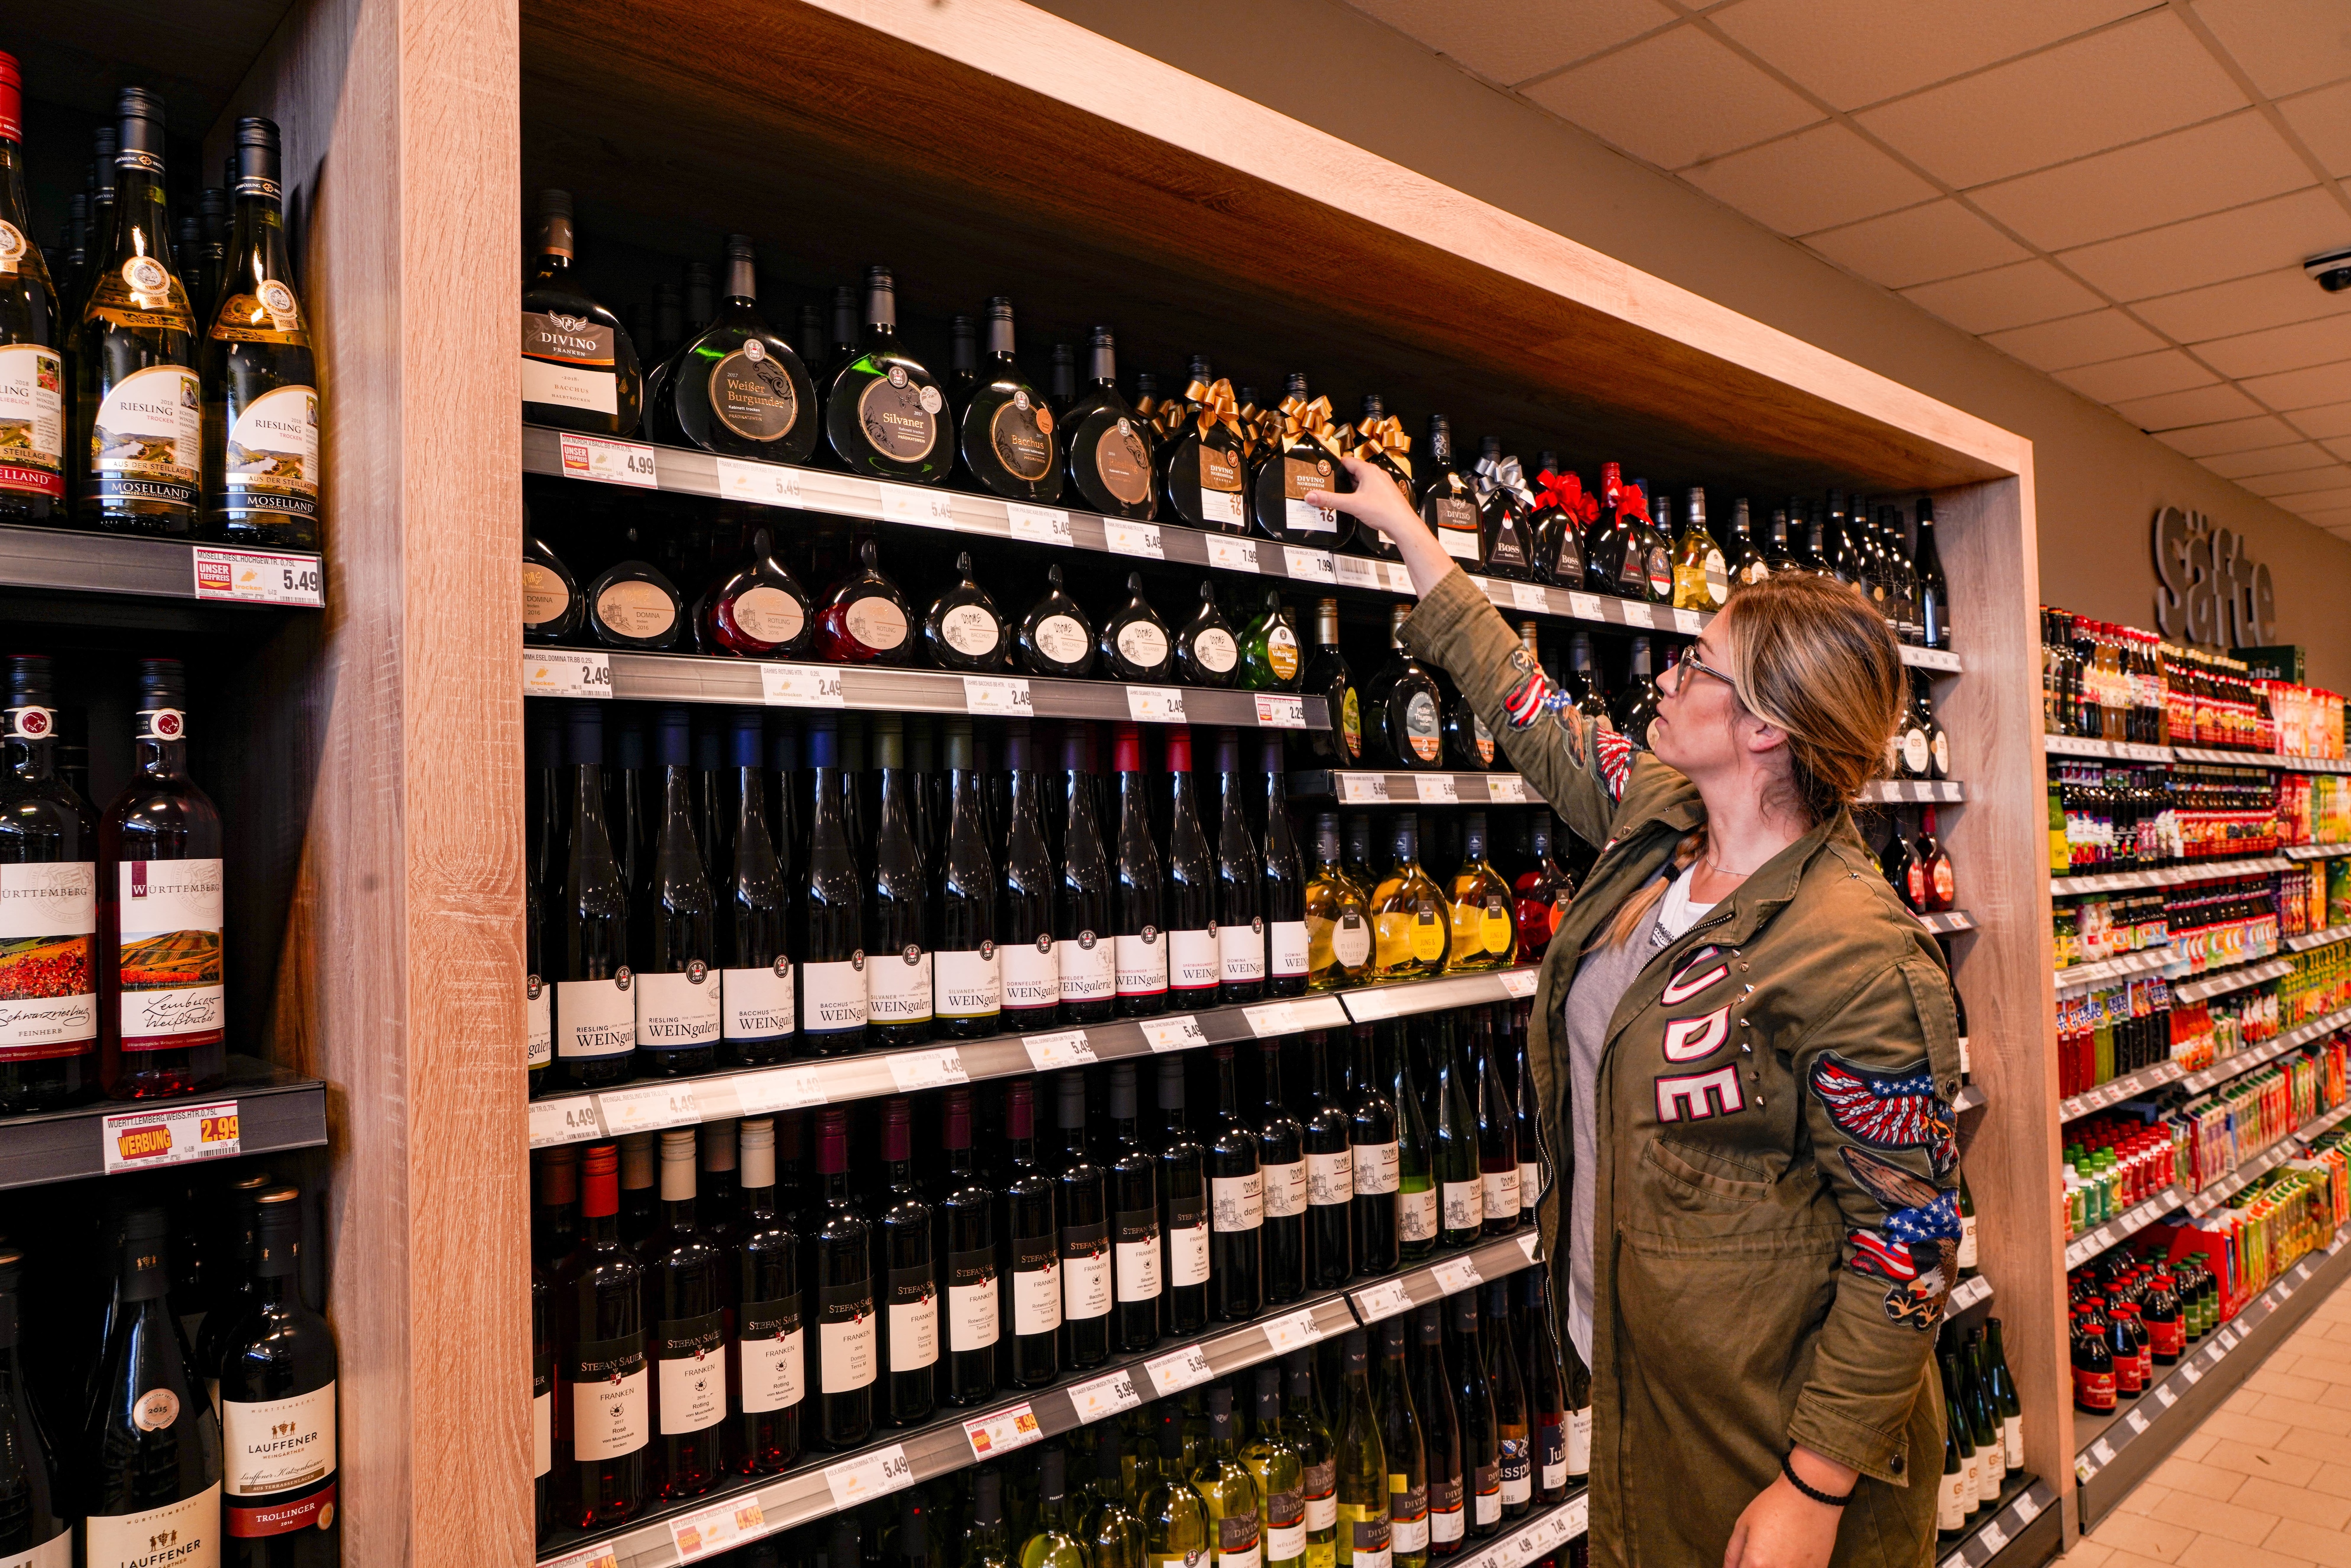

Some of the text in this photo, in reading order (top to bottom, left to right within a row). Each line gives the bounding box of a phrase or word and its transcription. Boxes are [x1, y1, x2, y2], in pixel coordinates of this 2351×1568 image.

[541, 331, 596, 351] DIVINO
[553, 347, 586, 357] FRANKEN
[554, 384, 589, 394] BACCHUS
[727, 379, 765, 394] Weißer
[551, 393, 591, 402] HALBTROCKEN
[728, 390, 785, 408] Burgunder
[120, 402, 173, 417] RIESLING
[146, 415, 174, 425] TROCKEN
[255, 419, 301, 433] RIESLING
[883, 412, 924, 429] Silvaner
[279, 432, 302, 441] TROCKEN
[1012, 434, 1044, 449] Bacchus
[4, 448, 46, 461] STEILLAGE
[564, 451, 587, 462] UNSER
[150, 464, 188, 476] STEILLAGE
[565, 459, 588, 470] TIEFPREIS
[628, 455, 654, 475] 4.99
[1210, 465, 1233, 475] DIVINO
[1210, 471, 1233, 480] NORDHEIM
[1297, 475, 1325, 487] DIVINO
[111, 482, 189, 499] MOSELLAND
[283, 479, 313, 490] STEILLAGE
[247, 496, 314, 513] MOSELLAND
[1447, 510, 1470, 520] DIVINO
[1053, 519, 1071, 536] 5.49
[199, 563, 229, 575] UNSER
[200, 573, 230, 583] TIEFPREIS
[284, 569, 319, 592] 5.49
[2155, 506, 2276, 648] Säfte
[527, 595, 553, 604] DOMINA
[767, 617, 790, 626] ROTLING
[876, 625, 896, 634] ROTLING
[583, 666, 611, 686] 2.49
[819, 679, 842, 696] 2.49
[1011, 690, 1031, 706] 2.49
[1167, 699, 1184, 713] 2.49
[1289, 706, 1304, 720] 2.29
[1373, 783, 1387, 796] 5.99
[1444, 783, 1455, 796] 5.99
[19, 1028, 63, 1037] FEINHERB
[1185, 1024, 1203, 1038] 5.49
[1072, 1038, 1092, 1055] 5.49
[566, 1107, 595, 1128] 4.49
[201, 1117, 239, 1143] 2.99
[118, 1128, 172, 1157] WERBUNG
[1136, 1247, 1157, 1257] FRANKEN
[1084, 1262, 1107, 1272] FRANKEN
[1033, 1277, 1057, 1288] FRANKEN
[970, 1291, 994, 1302] FRANKEN
[1089, 1292, 1104, 1300] Bacchus
[1393, 1287, 1410, 1303] 7.49
[911, 1310, 934, 1323] FRANKEN
[1301, 1319, 1318, 1335] 7.49
[843, 1329, 870, 1342] FRANKEN
[765, 1345, 795, 1357] FRANKEN
[850, 1353, 866, 1362] Domina
[684, 1363, 715, 1377] FRANKEN
[1186, 1355, 1207, 1373] 5.99
[773, 1380, 789, 1389] Rotling
[1114, 1380, 1135, 1400] 5.99
[600, 1387, 634, 1401] FRANKEN
[692, 1401, 709, 1410] Rotling
[1015, 1413, 1038, 1433] 5.99
[248, 1432, 318, 1453] LAUFFENER
[971, 1432, 991, 1448] WERBUNG
[262, 1447, 305, 1459] WEINGÄRTNER
[884, 1456, 908, 1478] 5.49
[255, 1502, 315, 1523] TROLLINGER
[735, 1505, 764, 1529] 4.99
[676, 1531, 700, 1549] WERBUNG
